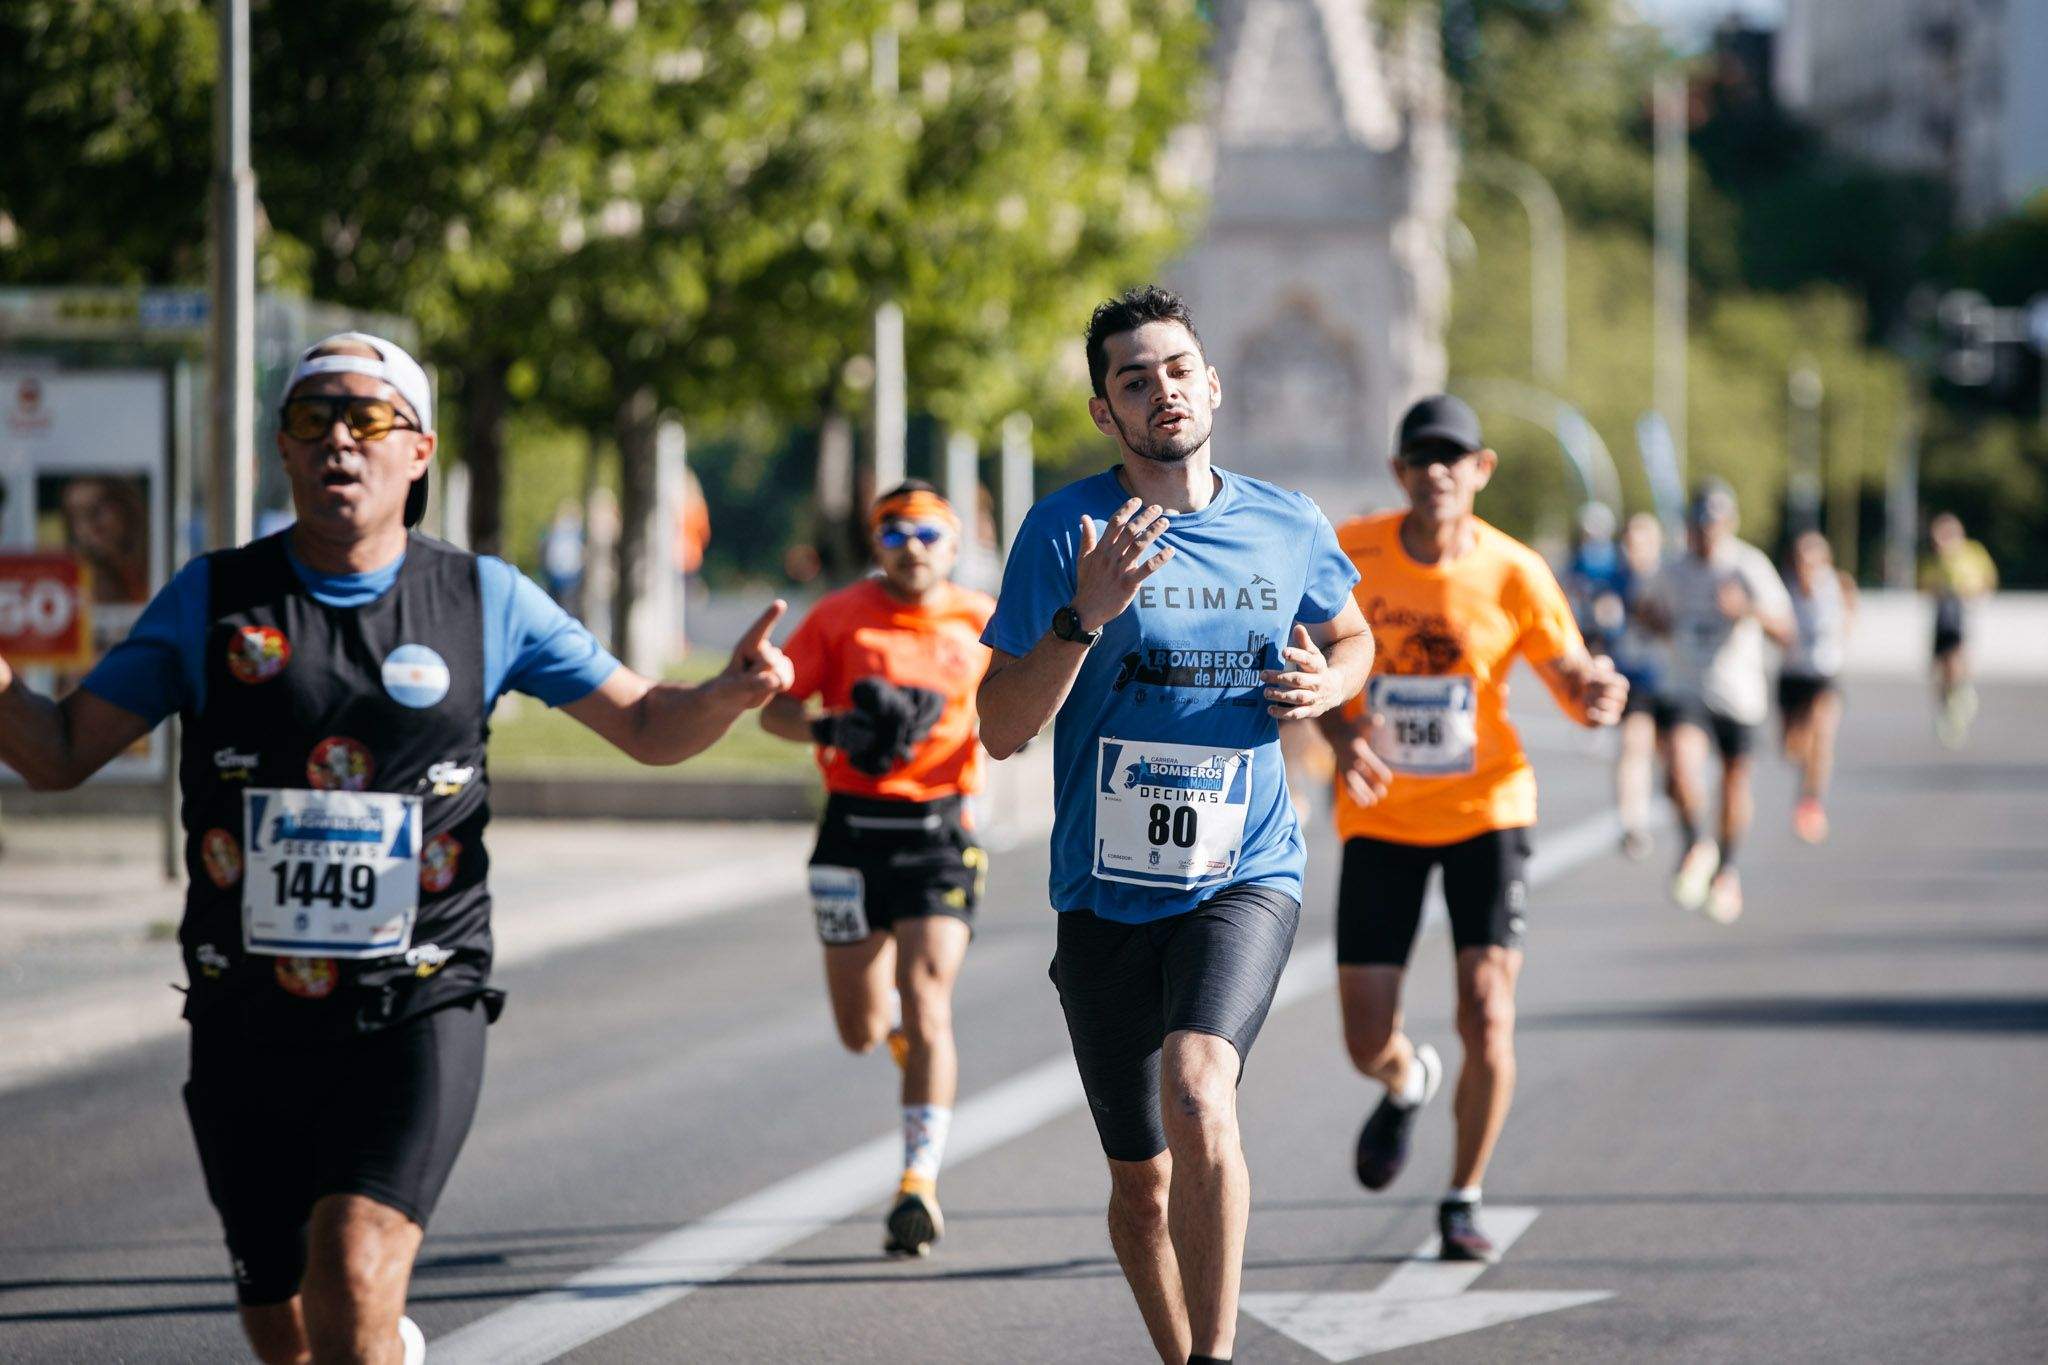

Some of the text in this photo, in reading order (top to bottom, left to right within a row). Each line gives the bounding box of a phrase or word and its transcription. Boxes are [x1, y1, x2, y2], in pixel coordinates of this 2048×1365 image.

[1139, 586, 1278, 611] ECIMAS
[1154, 650, 1262, 669] BOMBEROS
[1194, 668, 1263, 687] de MADRID
[1150, 756, 1179, 765] CARRERA
[1150, 763, 1223, 779] BOMBEROS
[1190, 778, 1221, 790] MADRID
[1140, 787, 1219, 804] DECIMAS
[1148, 803, 1198, 848] 80
[271, 860, 376, 910] 1449
